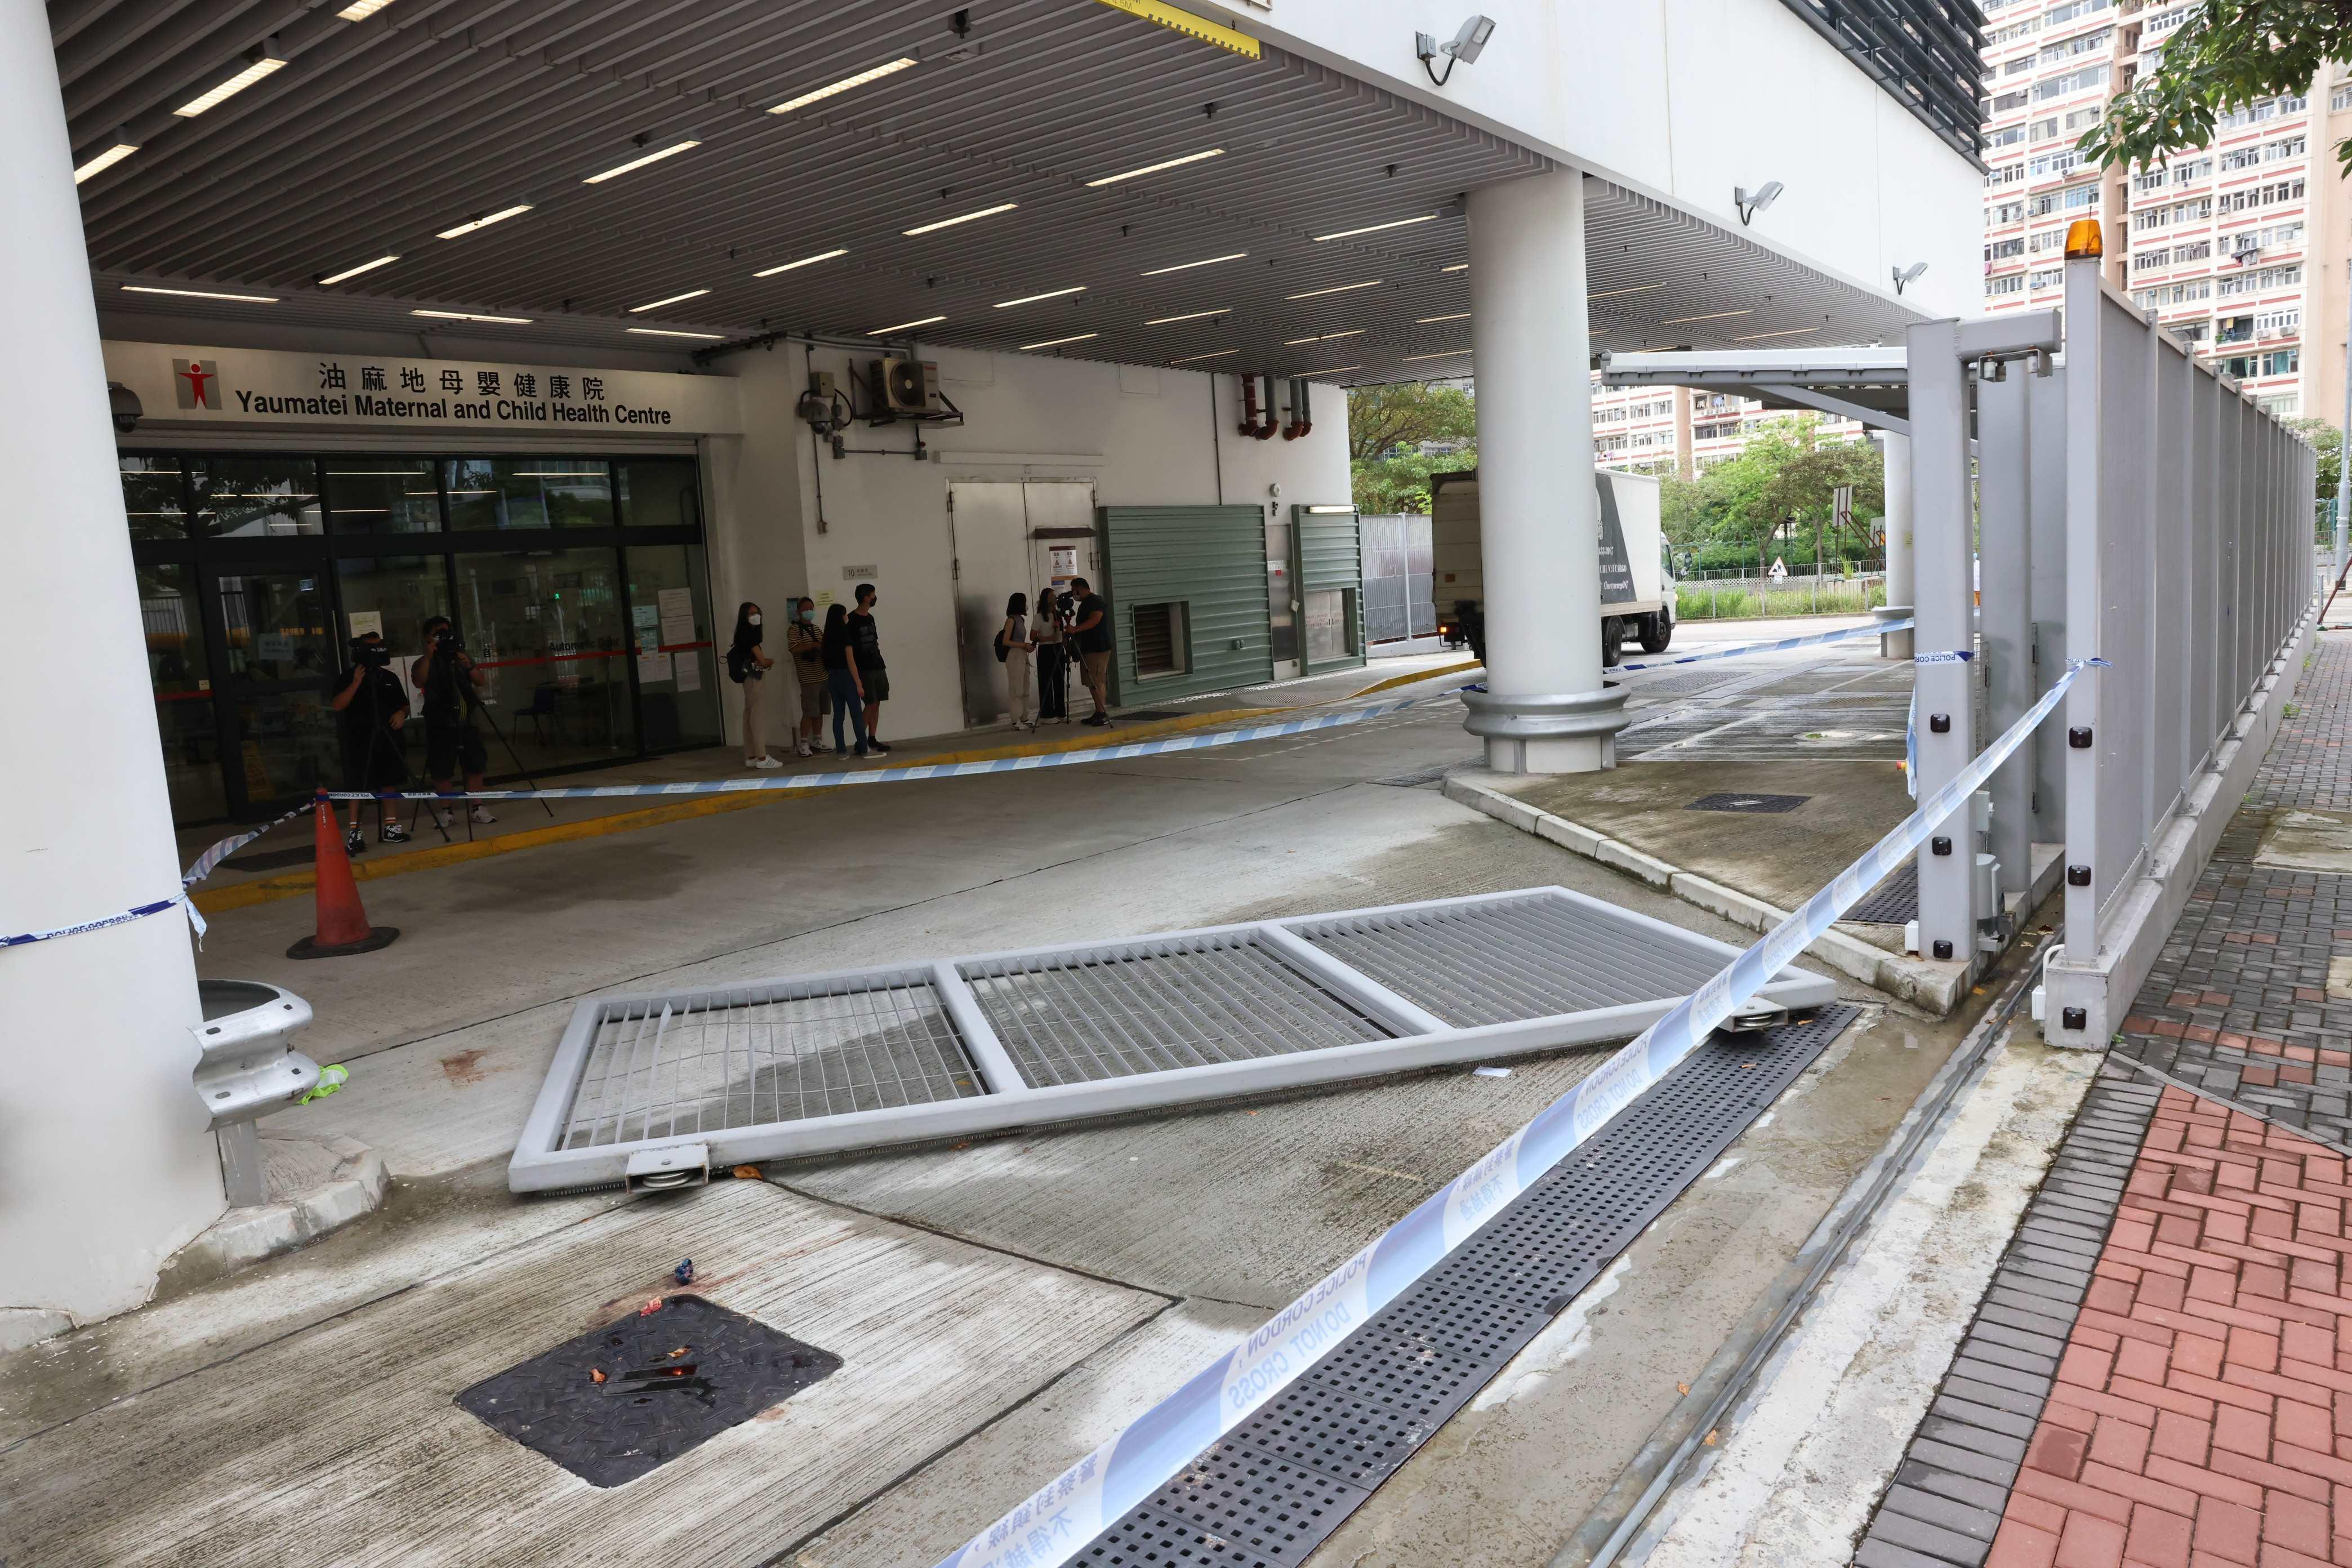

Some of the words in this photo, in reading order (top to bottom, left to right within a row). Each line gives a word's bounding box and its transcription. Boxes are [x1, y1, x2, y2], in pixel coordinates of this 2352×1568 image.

[318, 363, 605, 400] 油麻地母嬰健康院
[235, 390, 348, 415] Yaumatei
[355, 395, 447, 418] Maternal
[453, 400, 491, 419] and
[497, 400, 546, 421] Child
[552, 402, 609, 423] Health
[614, 404, 671, 425] Centre
